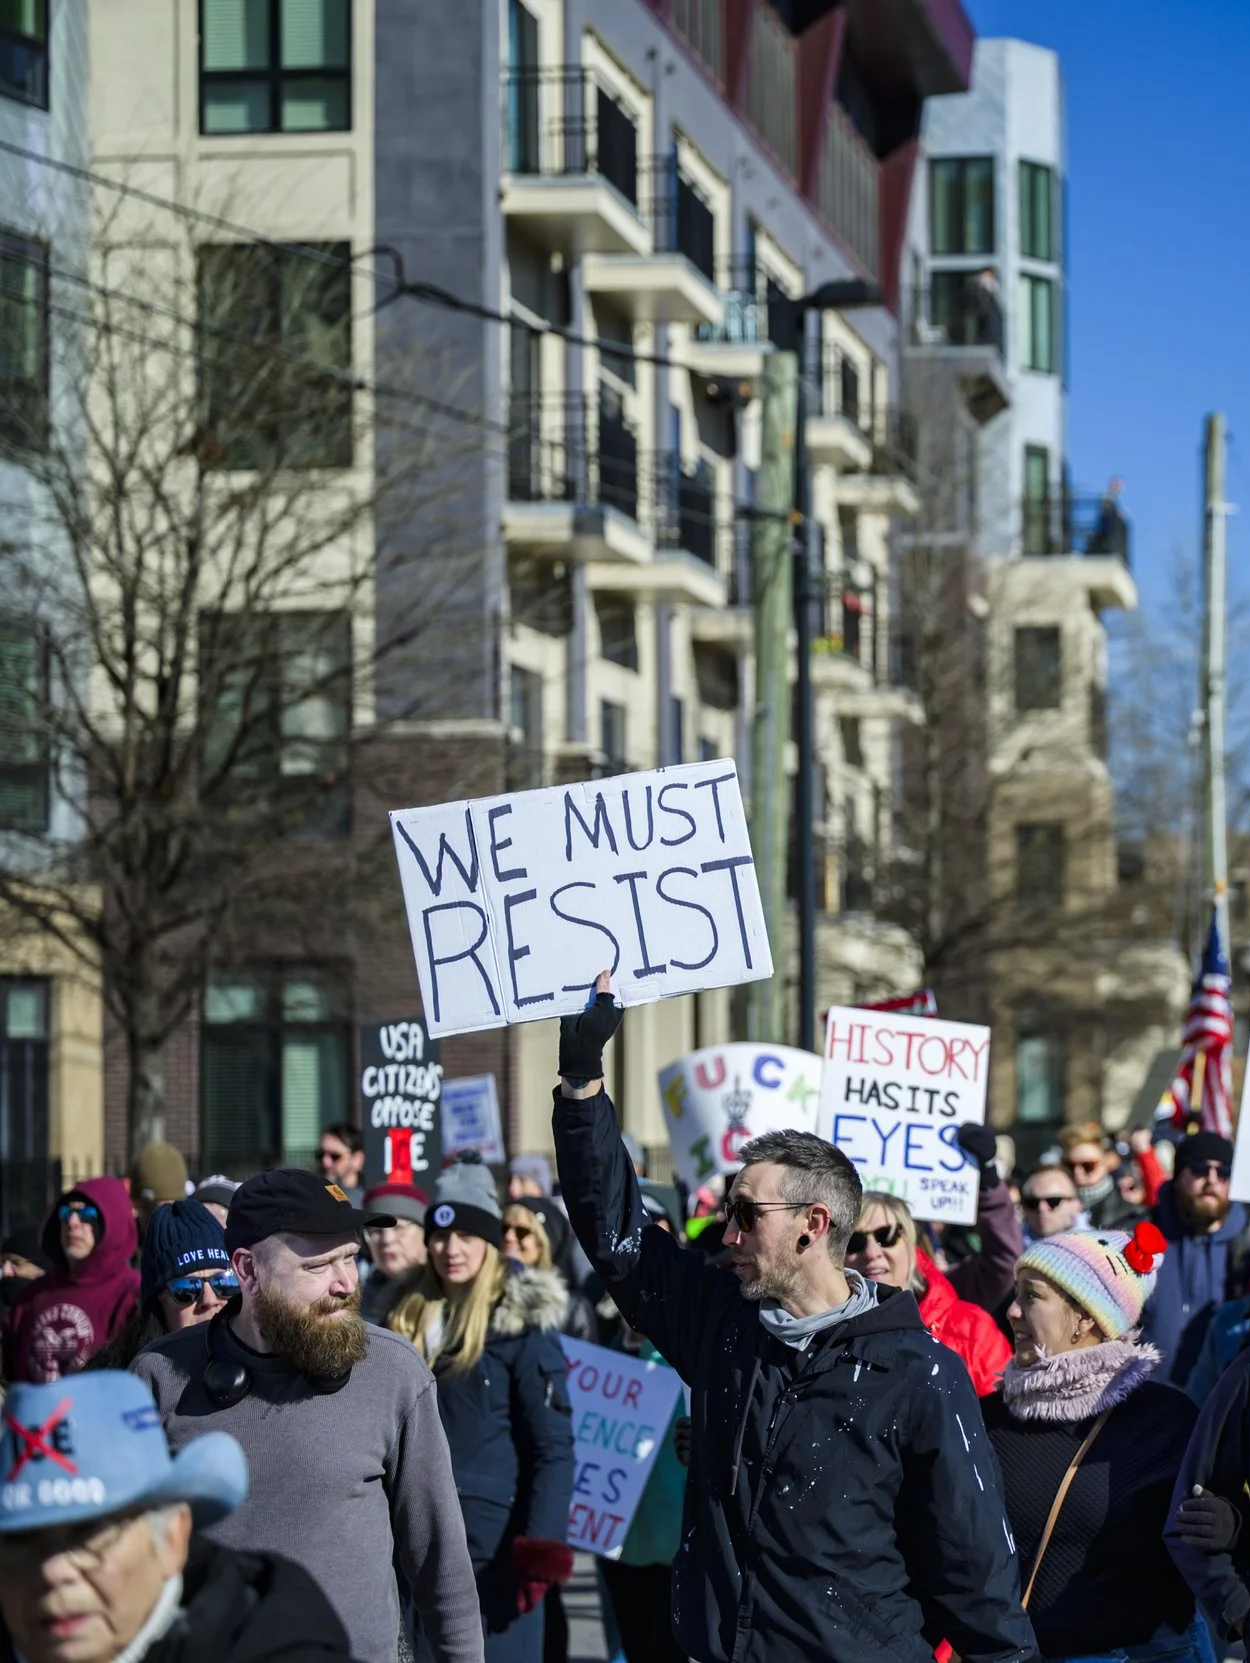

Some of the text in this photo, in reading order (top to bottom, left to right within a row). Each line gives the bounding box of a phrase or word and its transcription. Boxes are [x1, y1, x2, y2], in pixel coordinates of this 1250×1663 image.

[397, 773, 736, 896] WE MUST
[422, 856, 754, 1022] RESIST
[379, 1021, 424, 1061] USA
[829, 1021, 990, 1082] HISTORY
[361, 1061, 444, 1100] CITIZENS
[844, 1076, 960, 1117] HAS ITS
[371, 1095, 436, 1131] OPPOSE
[832, 1114, 968, 1172] EYES
[919, 1178, 970, 1196] SPEAK
[177, 1249, 205, 1266] LOVE
[564, 1356, 644, 1410] YOUR
